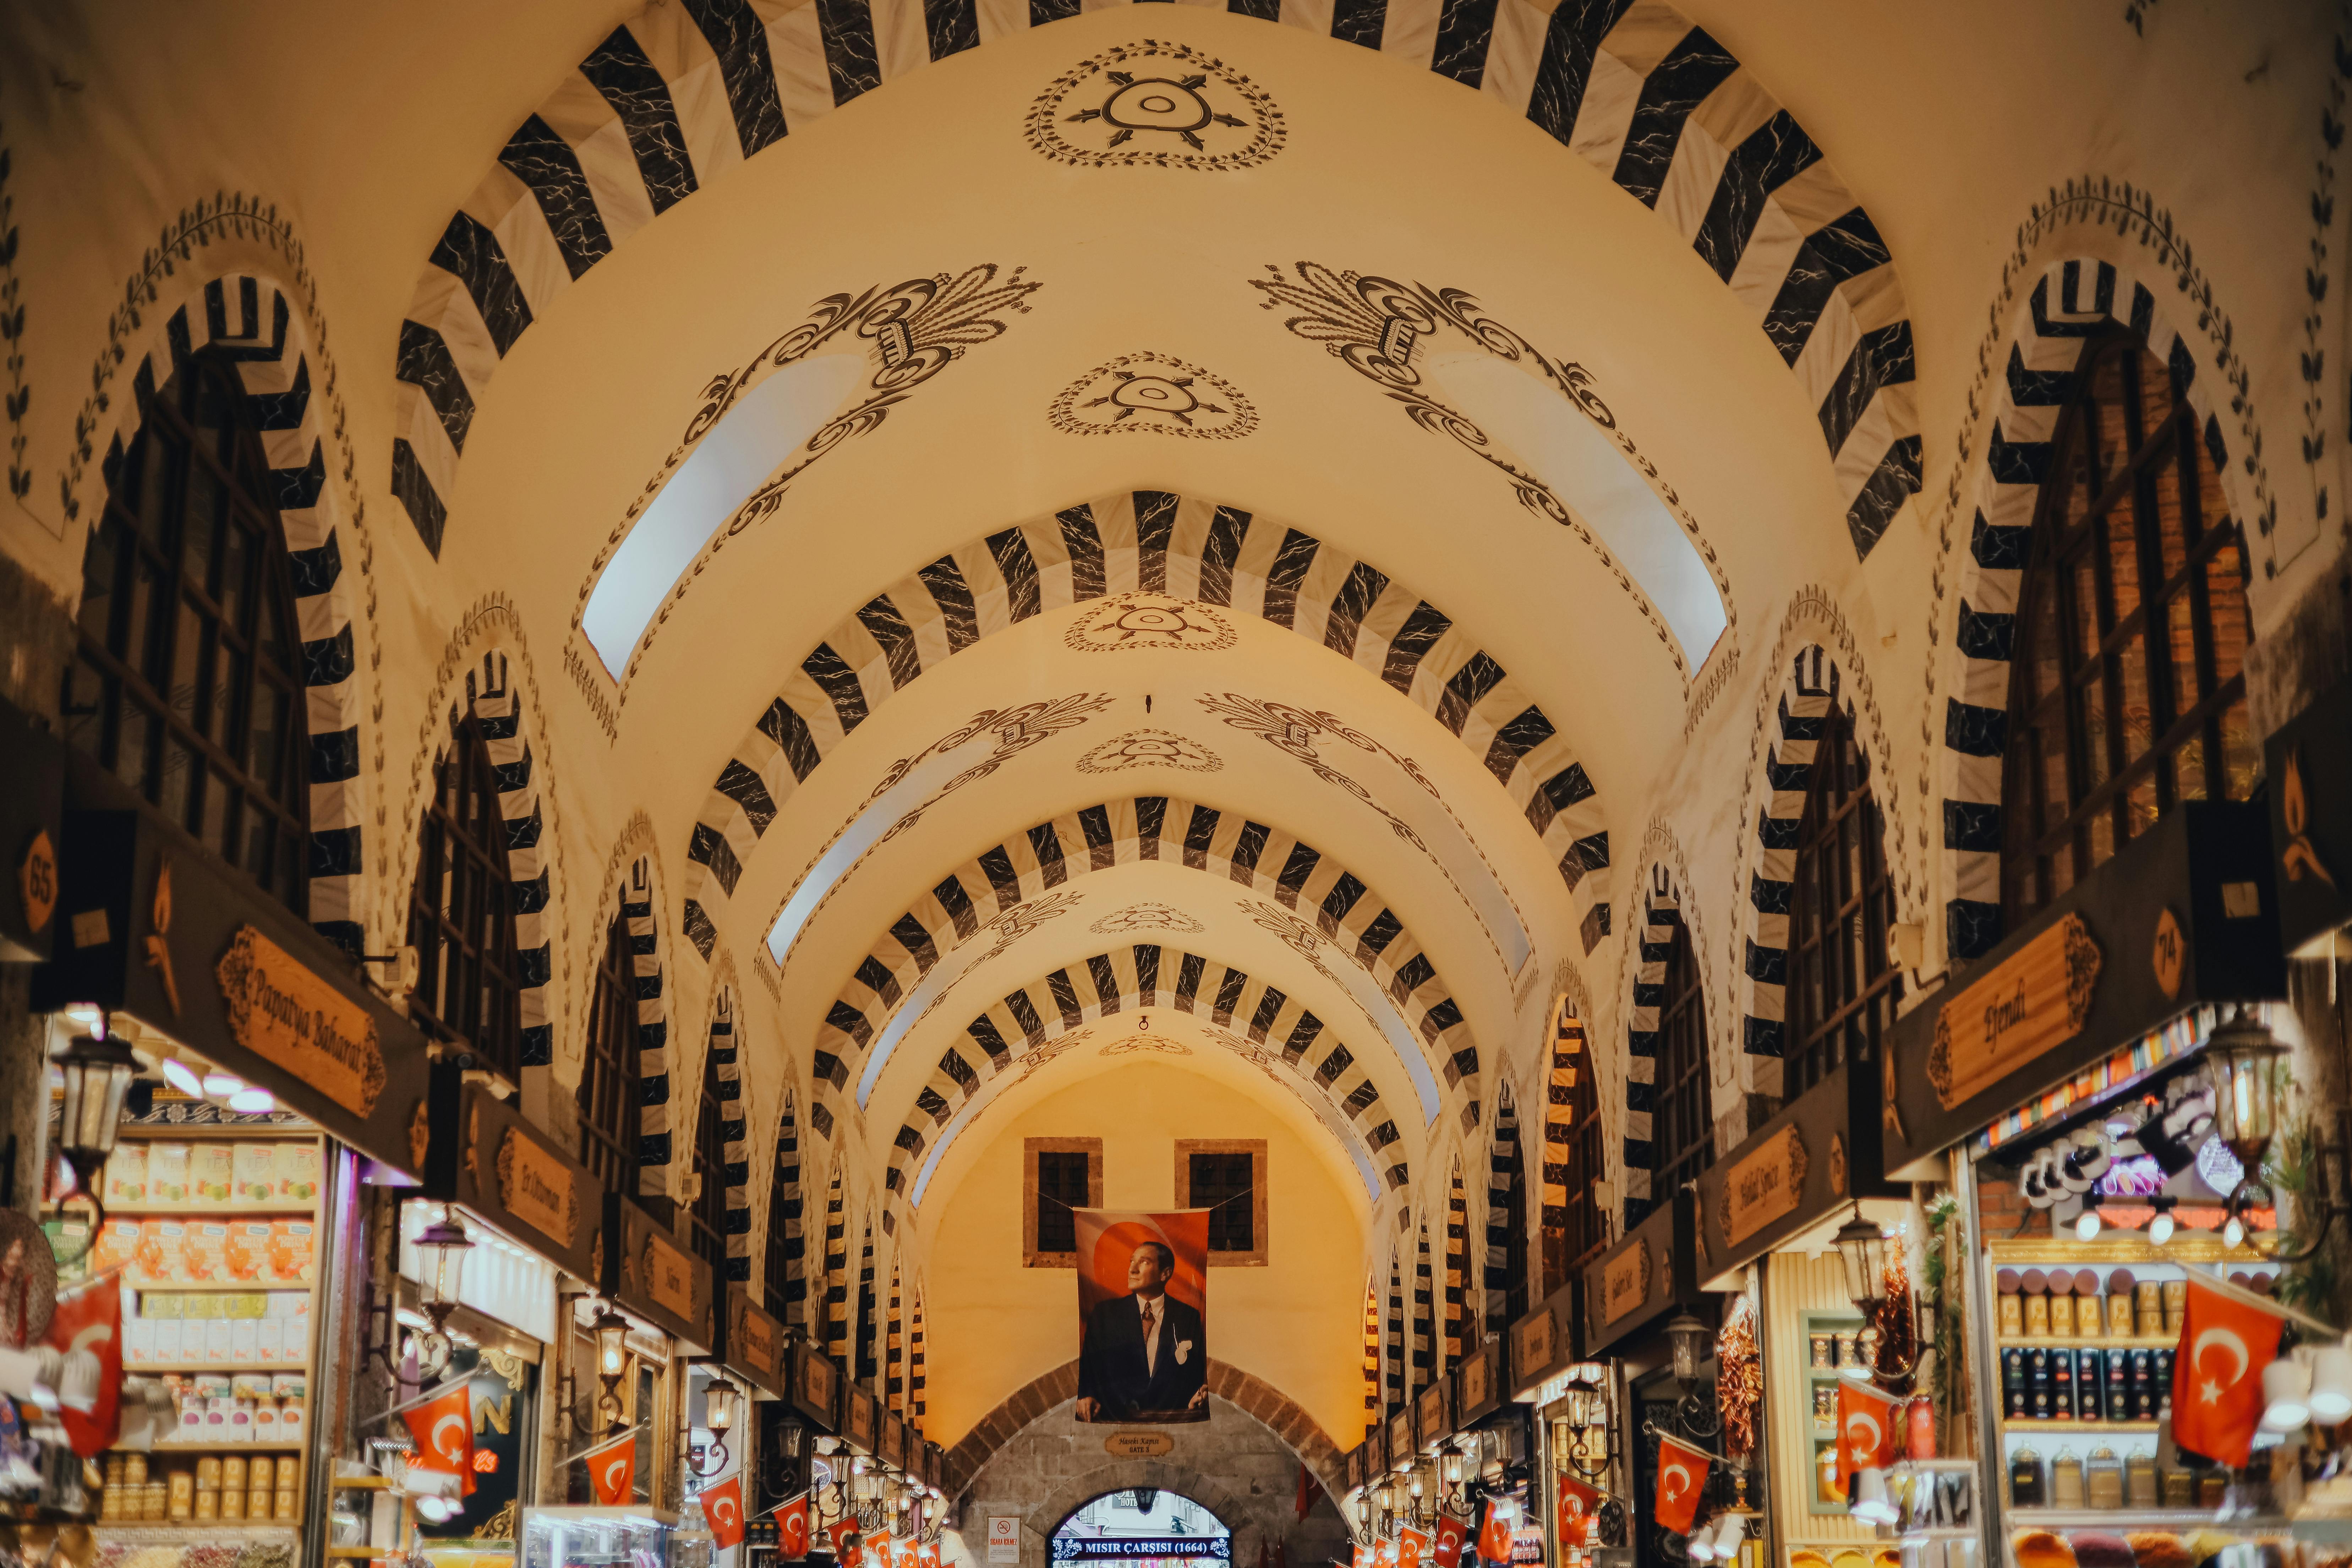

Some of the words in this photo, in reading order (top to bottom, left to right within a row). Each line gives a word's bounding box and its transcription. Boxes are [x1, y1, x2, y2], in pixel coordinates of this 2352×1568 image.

[30, 854, 51, 904] 65
[2159, 928, 2176, 975] 74
[253, 968, 309, 1047] Papatya
[312, 1010, 361, 1073] Baharat
[1140, 1438, 1159, 1446] Kapısı
[1118, 1498, 1138, 1507] HOTE
[1004, 1537, 1017, 1546] İÇİLMEZ
[1085, 1543, 1121, 1553] MISIR
[1124, 1543, 1172, 1554] ÇARŞISI
[1175, 1543, 1207, 1554] (1664)
